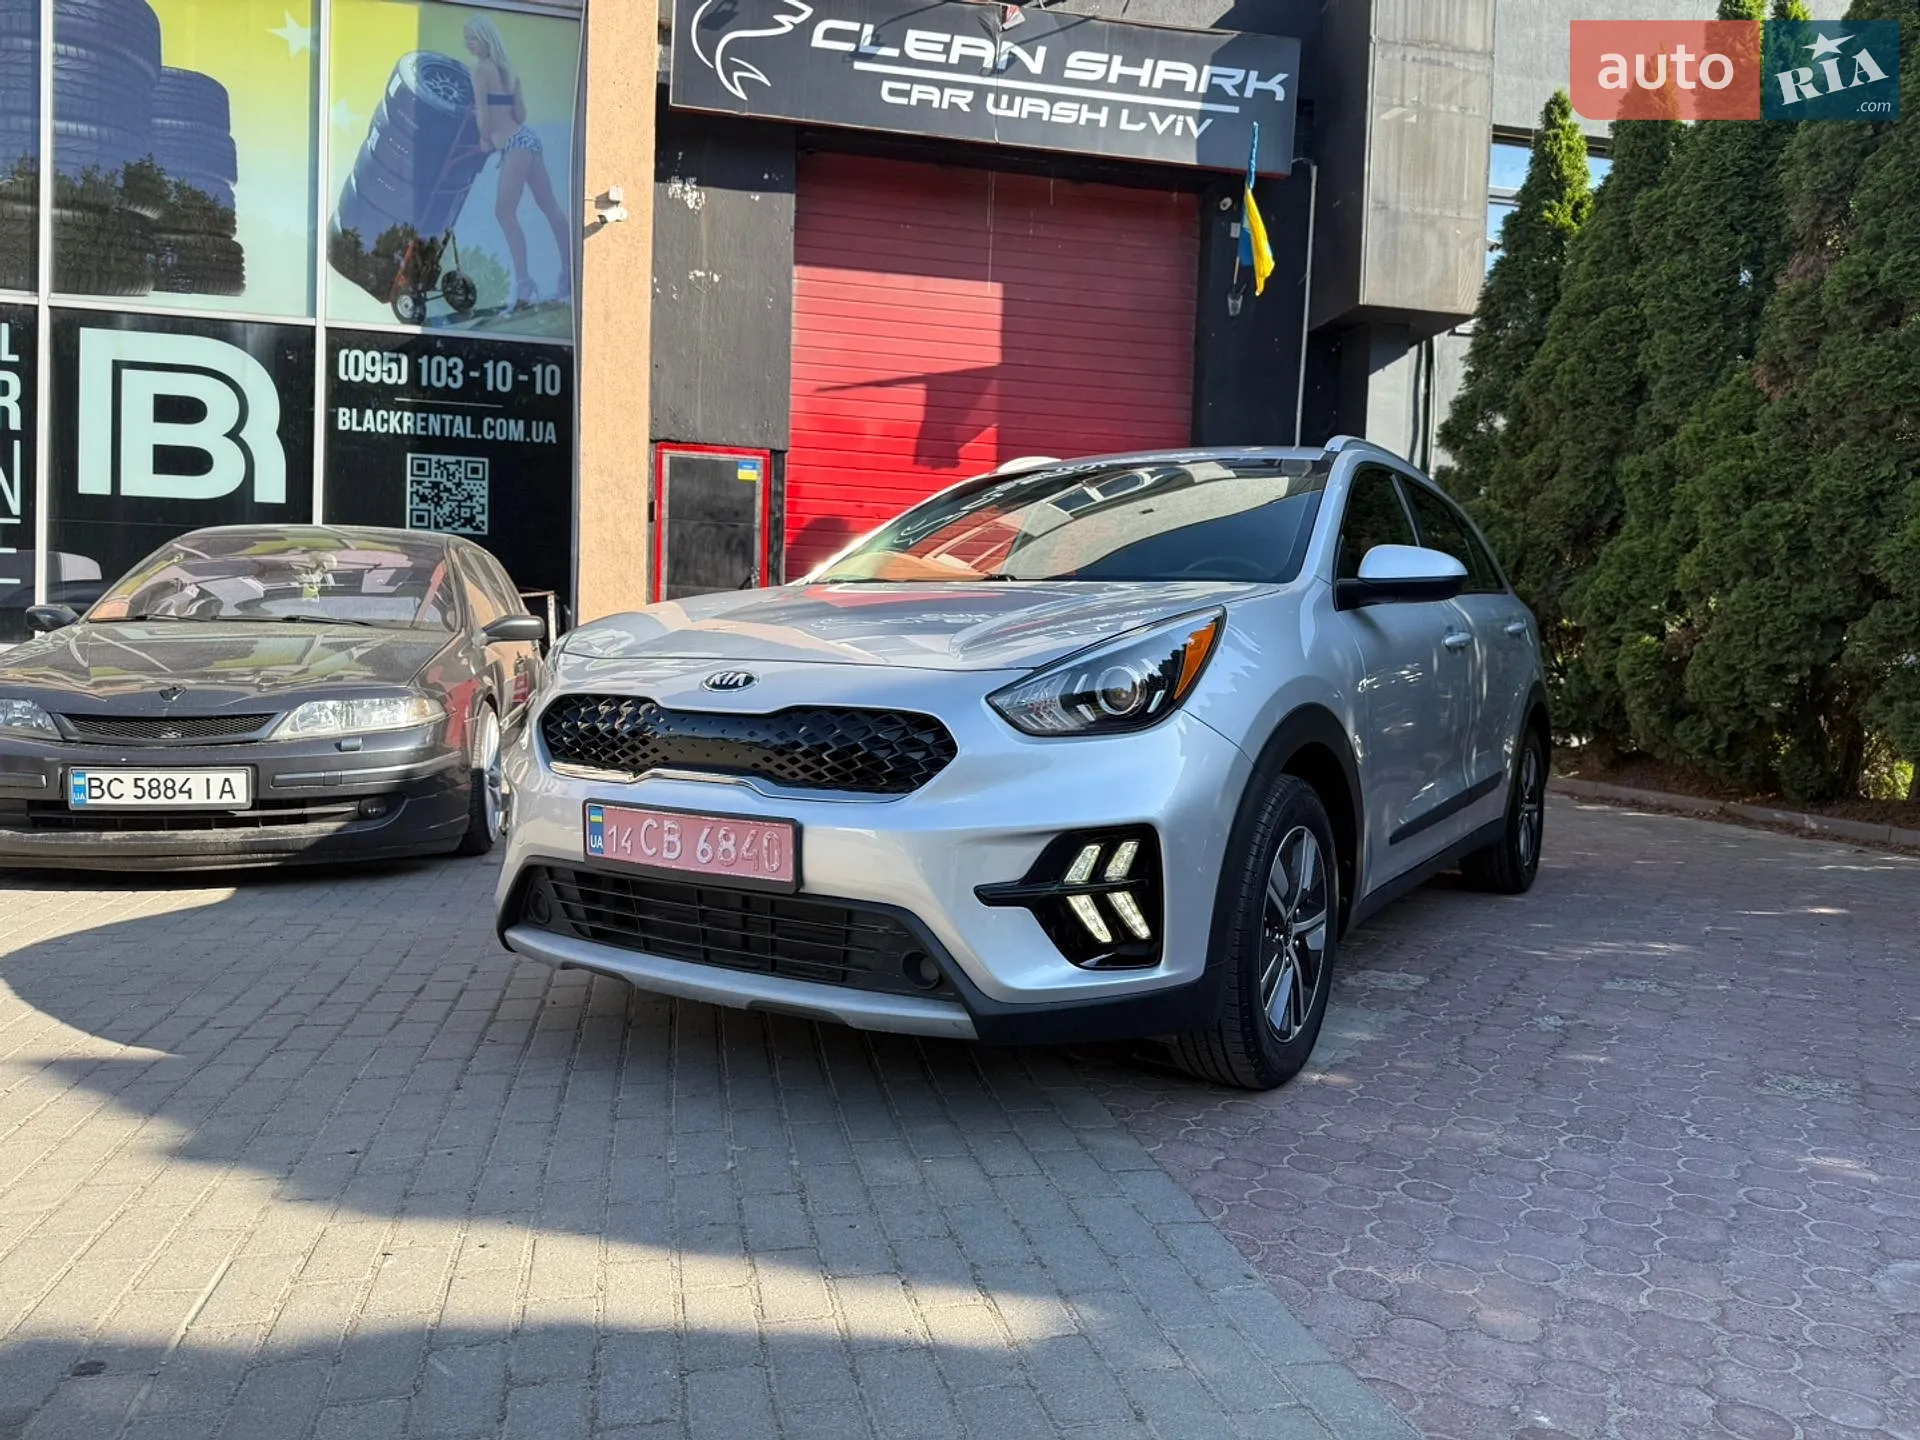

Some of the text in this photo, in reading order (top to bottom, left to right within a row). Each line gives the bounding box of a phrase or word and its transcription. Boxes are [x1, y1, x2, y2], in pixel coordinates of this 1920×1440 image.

[811, 19, 1289, 101] CLEAN SHARK
[881, 80, 975, 112] CAR
[986, 93, 1109, 128] WASH
[338, 349, 408, 385] (095)
[338, 407, 557, 444] BLACKRENTAL.COM.UA
[709, 672, 748, 687] KIA
[88, 777, 124, 800] BC
[133, 777, 193, 800] 5884
[590, 834, 603, 849] UA
[608, 817, 782, 873] 14 CB 6840
